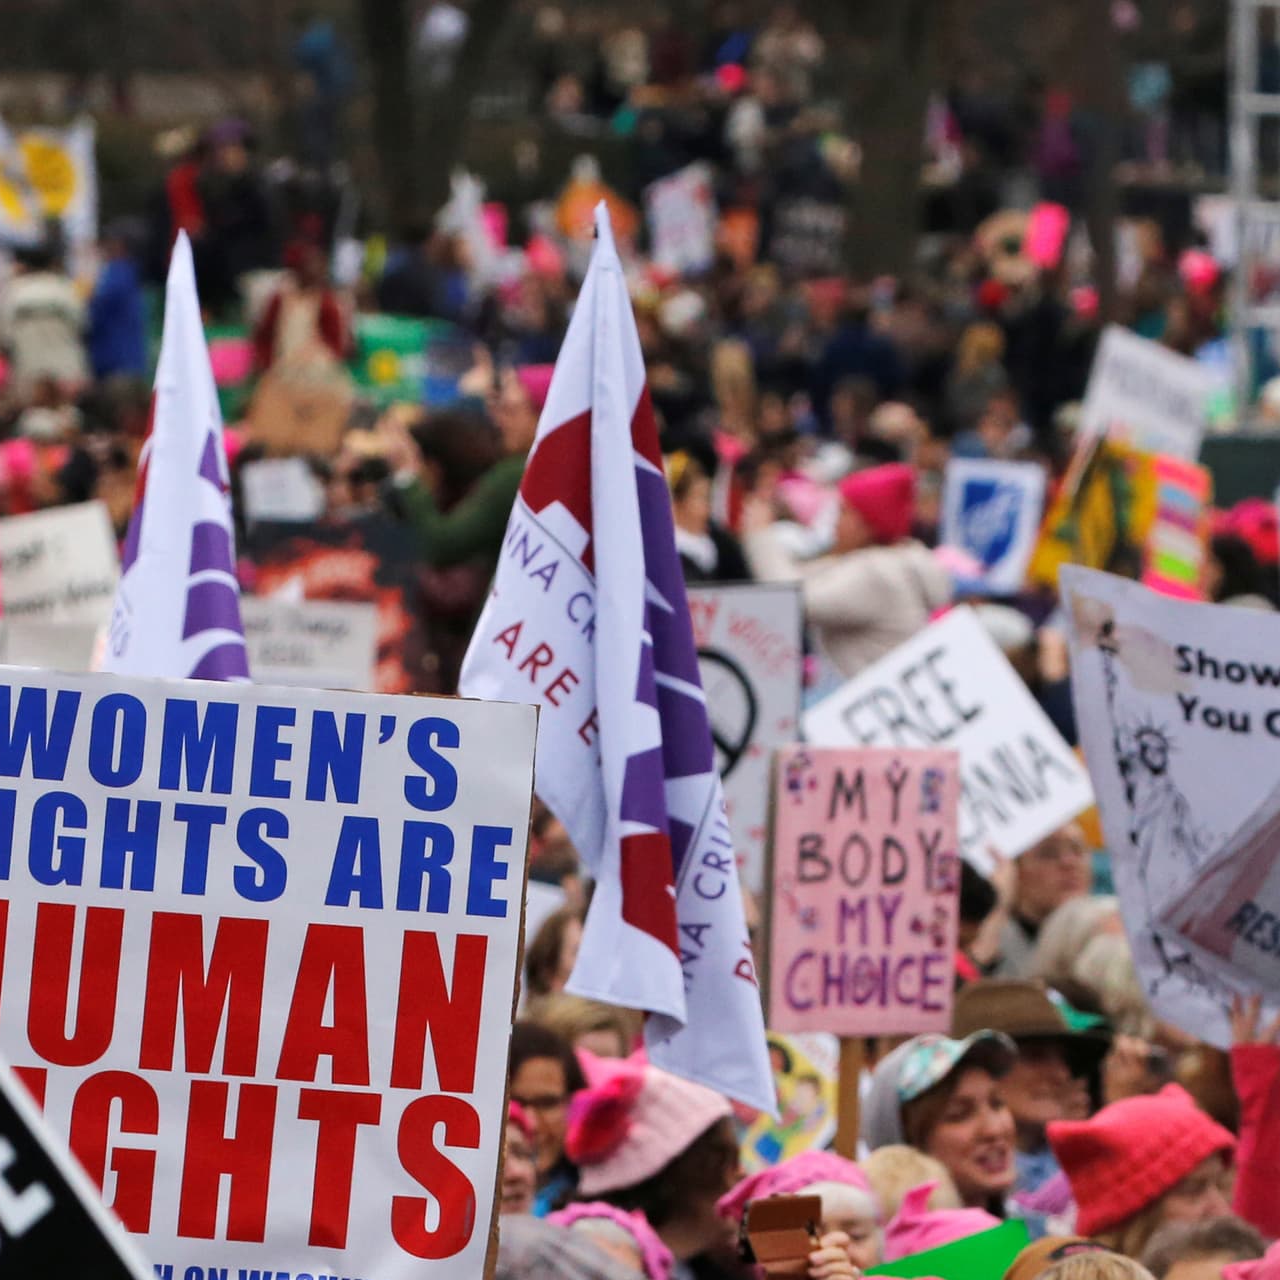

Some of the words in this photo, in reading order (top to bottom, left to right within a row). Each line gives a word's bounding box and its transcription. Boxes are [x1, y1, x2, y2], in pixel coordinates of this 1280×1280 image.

[493, 620, 581, 708] ARE
[840, 646, 984, 747] FREE
[1176, 691, 1252, 735] You
[826, 766, 911, 823] MY
[325, 815, 514, 919] ARE
[797, 828, 946, 893] BODY
[837, 893, 904, 946] MY
[783, 951, 948, 1013] CHOICE
